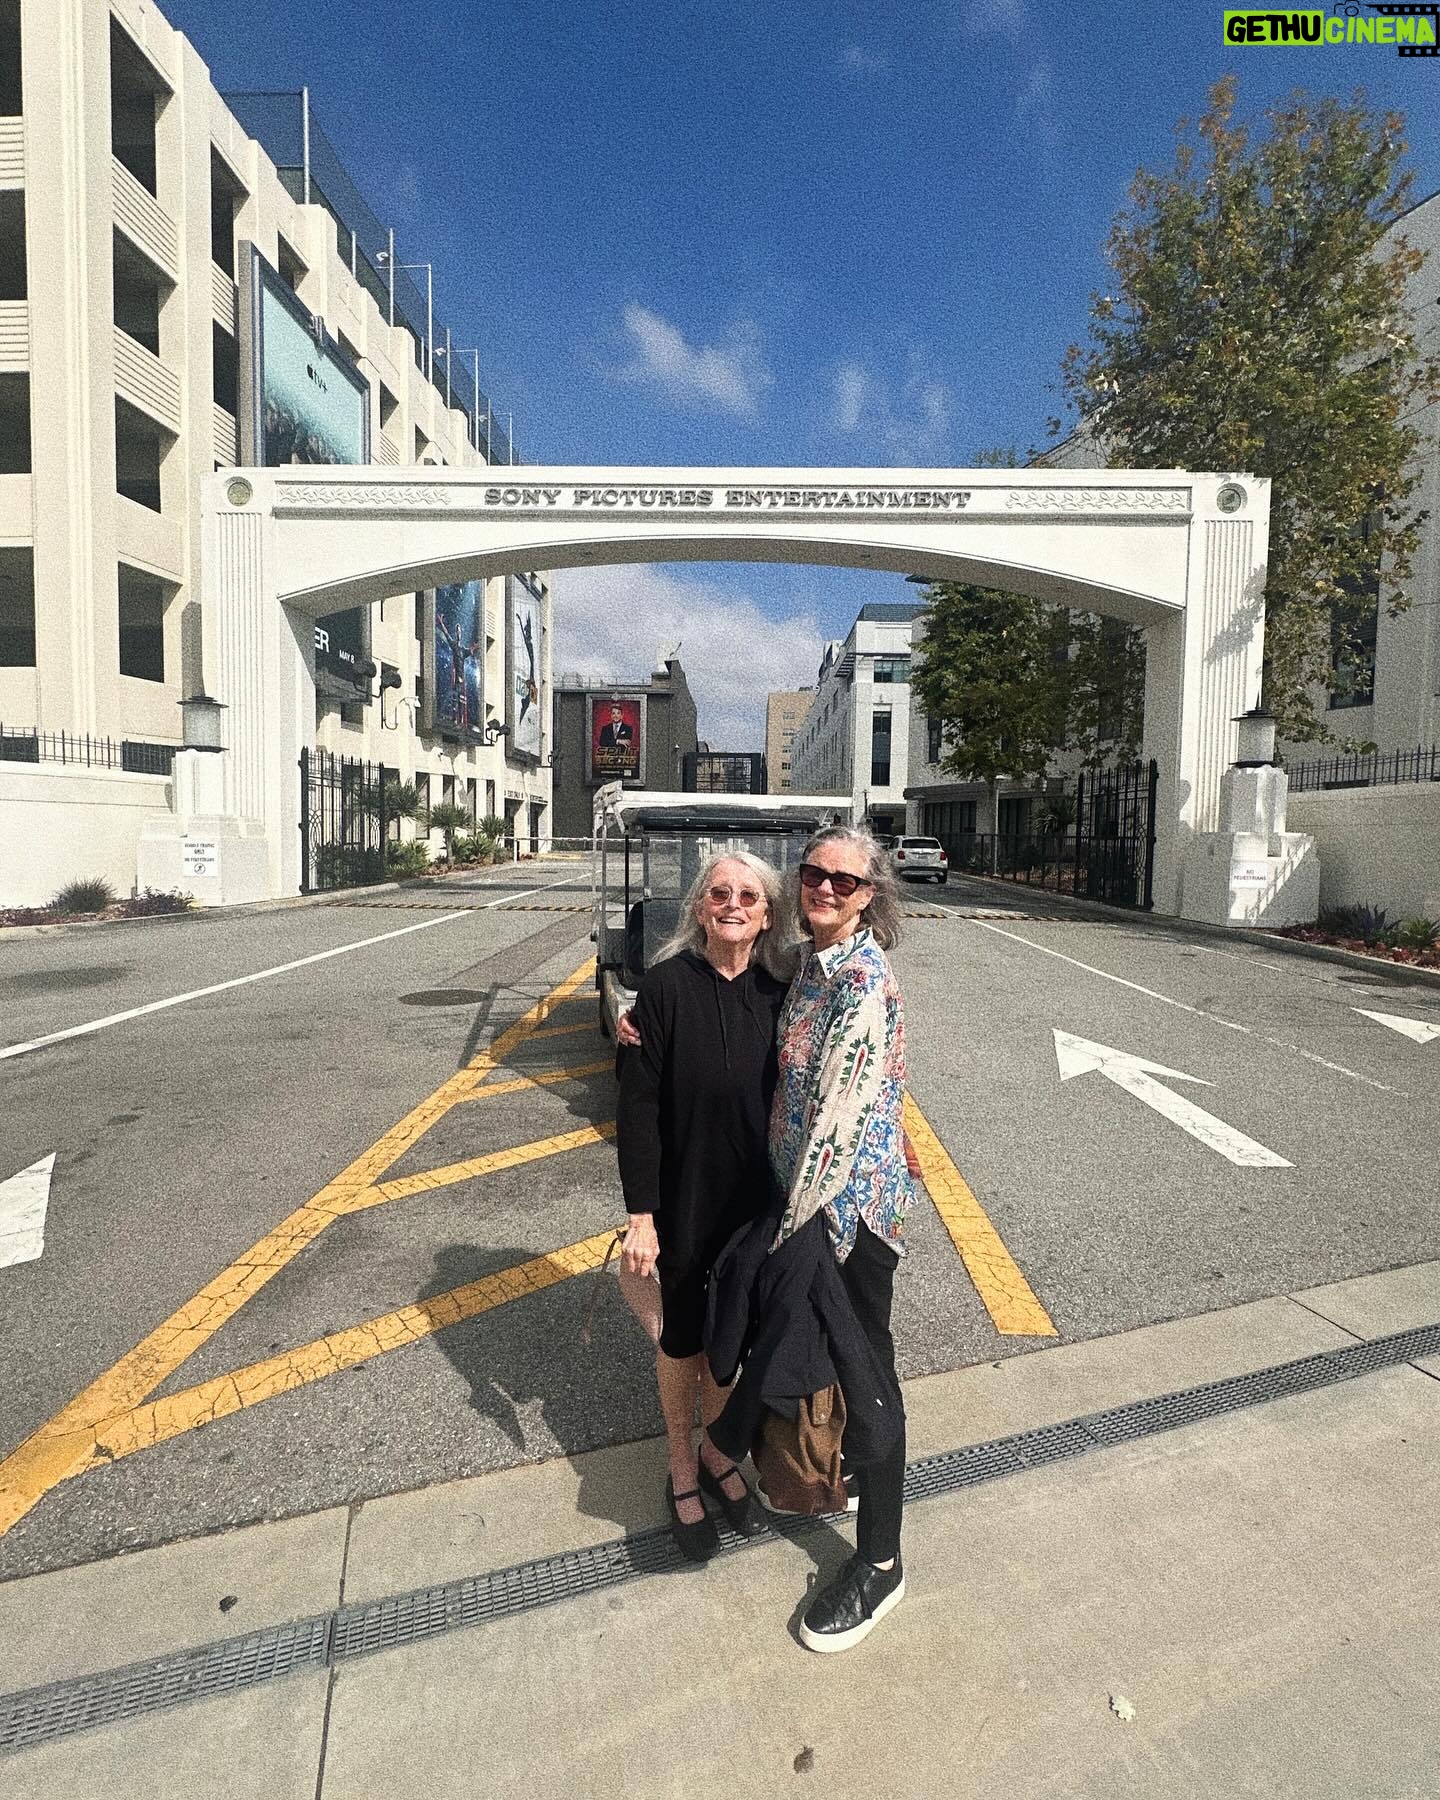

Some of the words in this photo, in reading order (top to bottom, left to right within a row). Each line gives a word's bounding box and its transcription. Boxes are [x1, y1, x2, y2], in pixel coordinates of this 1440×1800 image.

[484, 488, 561, 506] SONY
[573, 489, 713, 507] PICTURES
[724, 490, 971, 509] ENTERTAINMENT
[339, 649, 350, 662] MAY
[597, 747, 639, 757] SPLIT
[596, 757, 637, 766] SECOND
